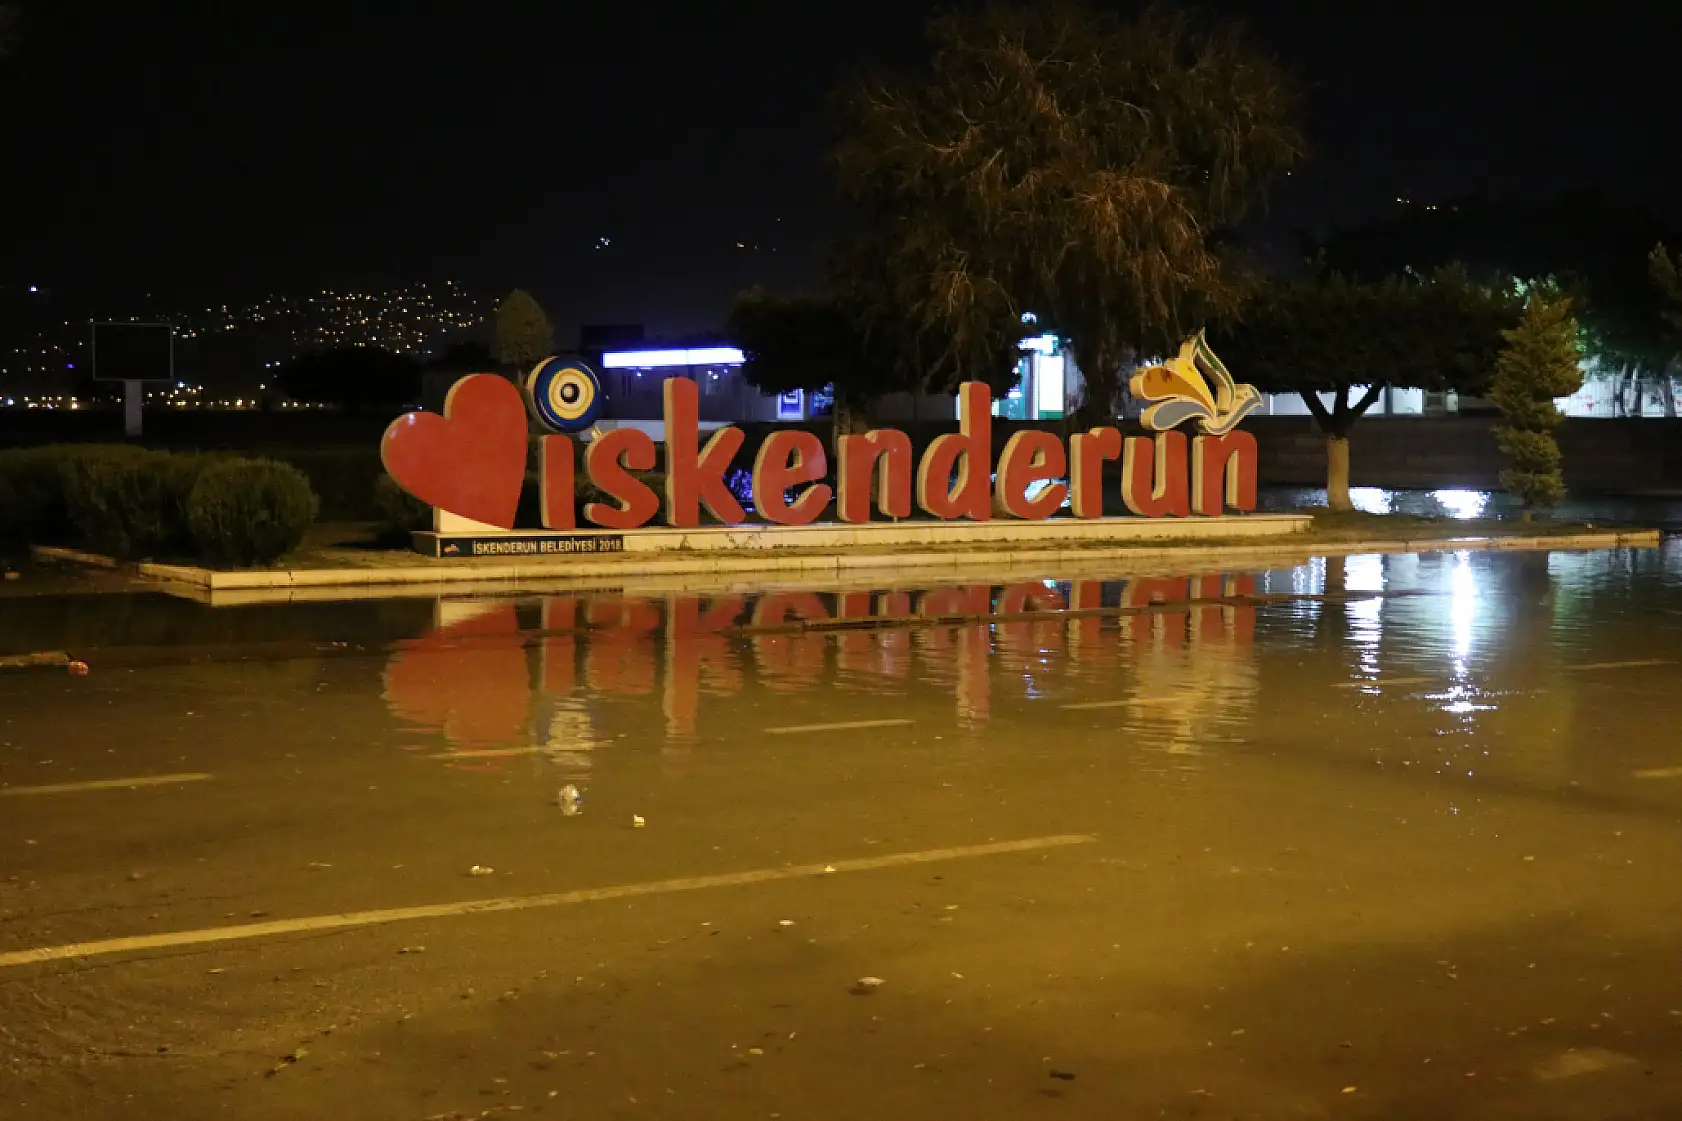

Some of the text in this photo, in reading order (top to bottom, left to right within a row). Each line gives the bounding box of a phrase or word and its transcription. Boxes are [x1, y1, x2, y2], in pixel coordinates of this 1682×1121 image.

[528, 356, 1258, 529] iskenderun
[473, 540, 537, 555] İSKENDERUN
[540, 537, 596, 553] BELEDİYESİ
